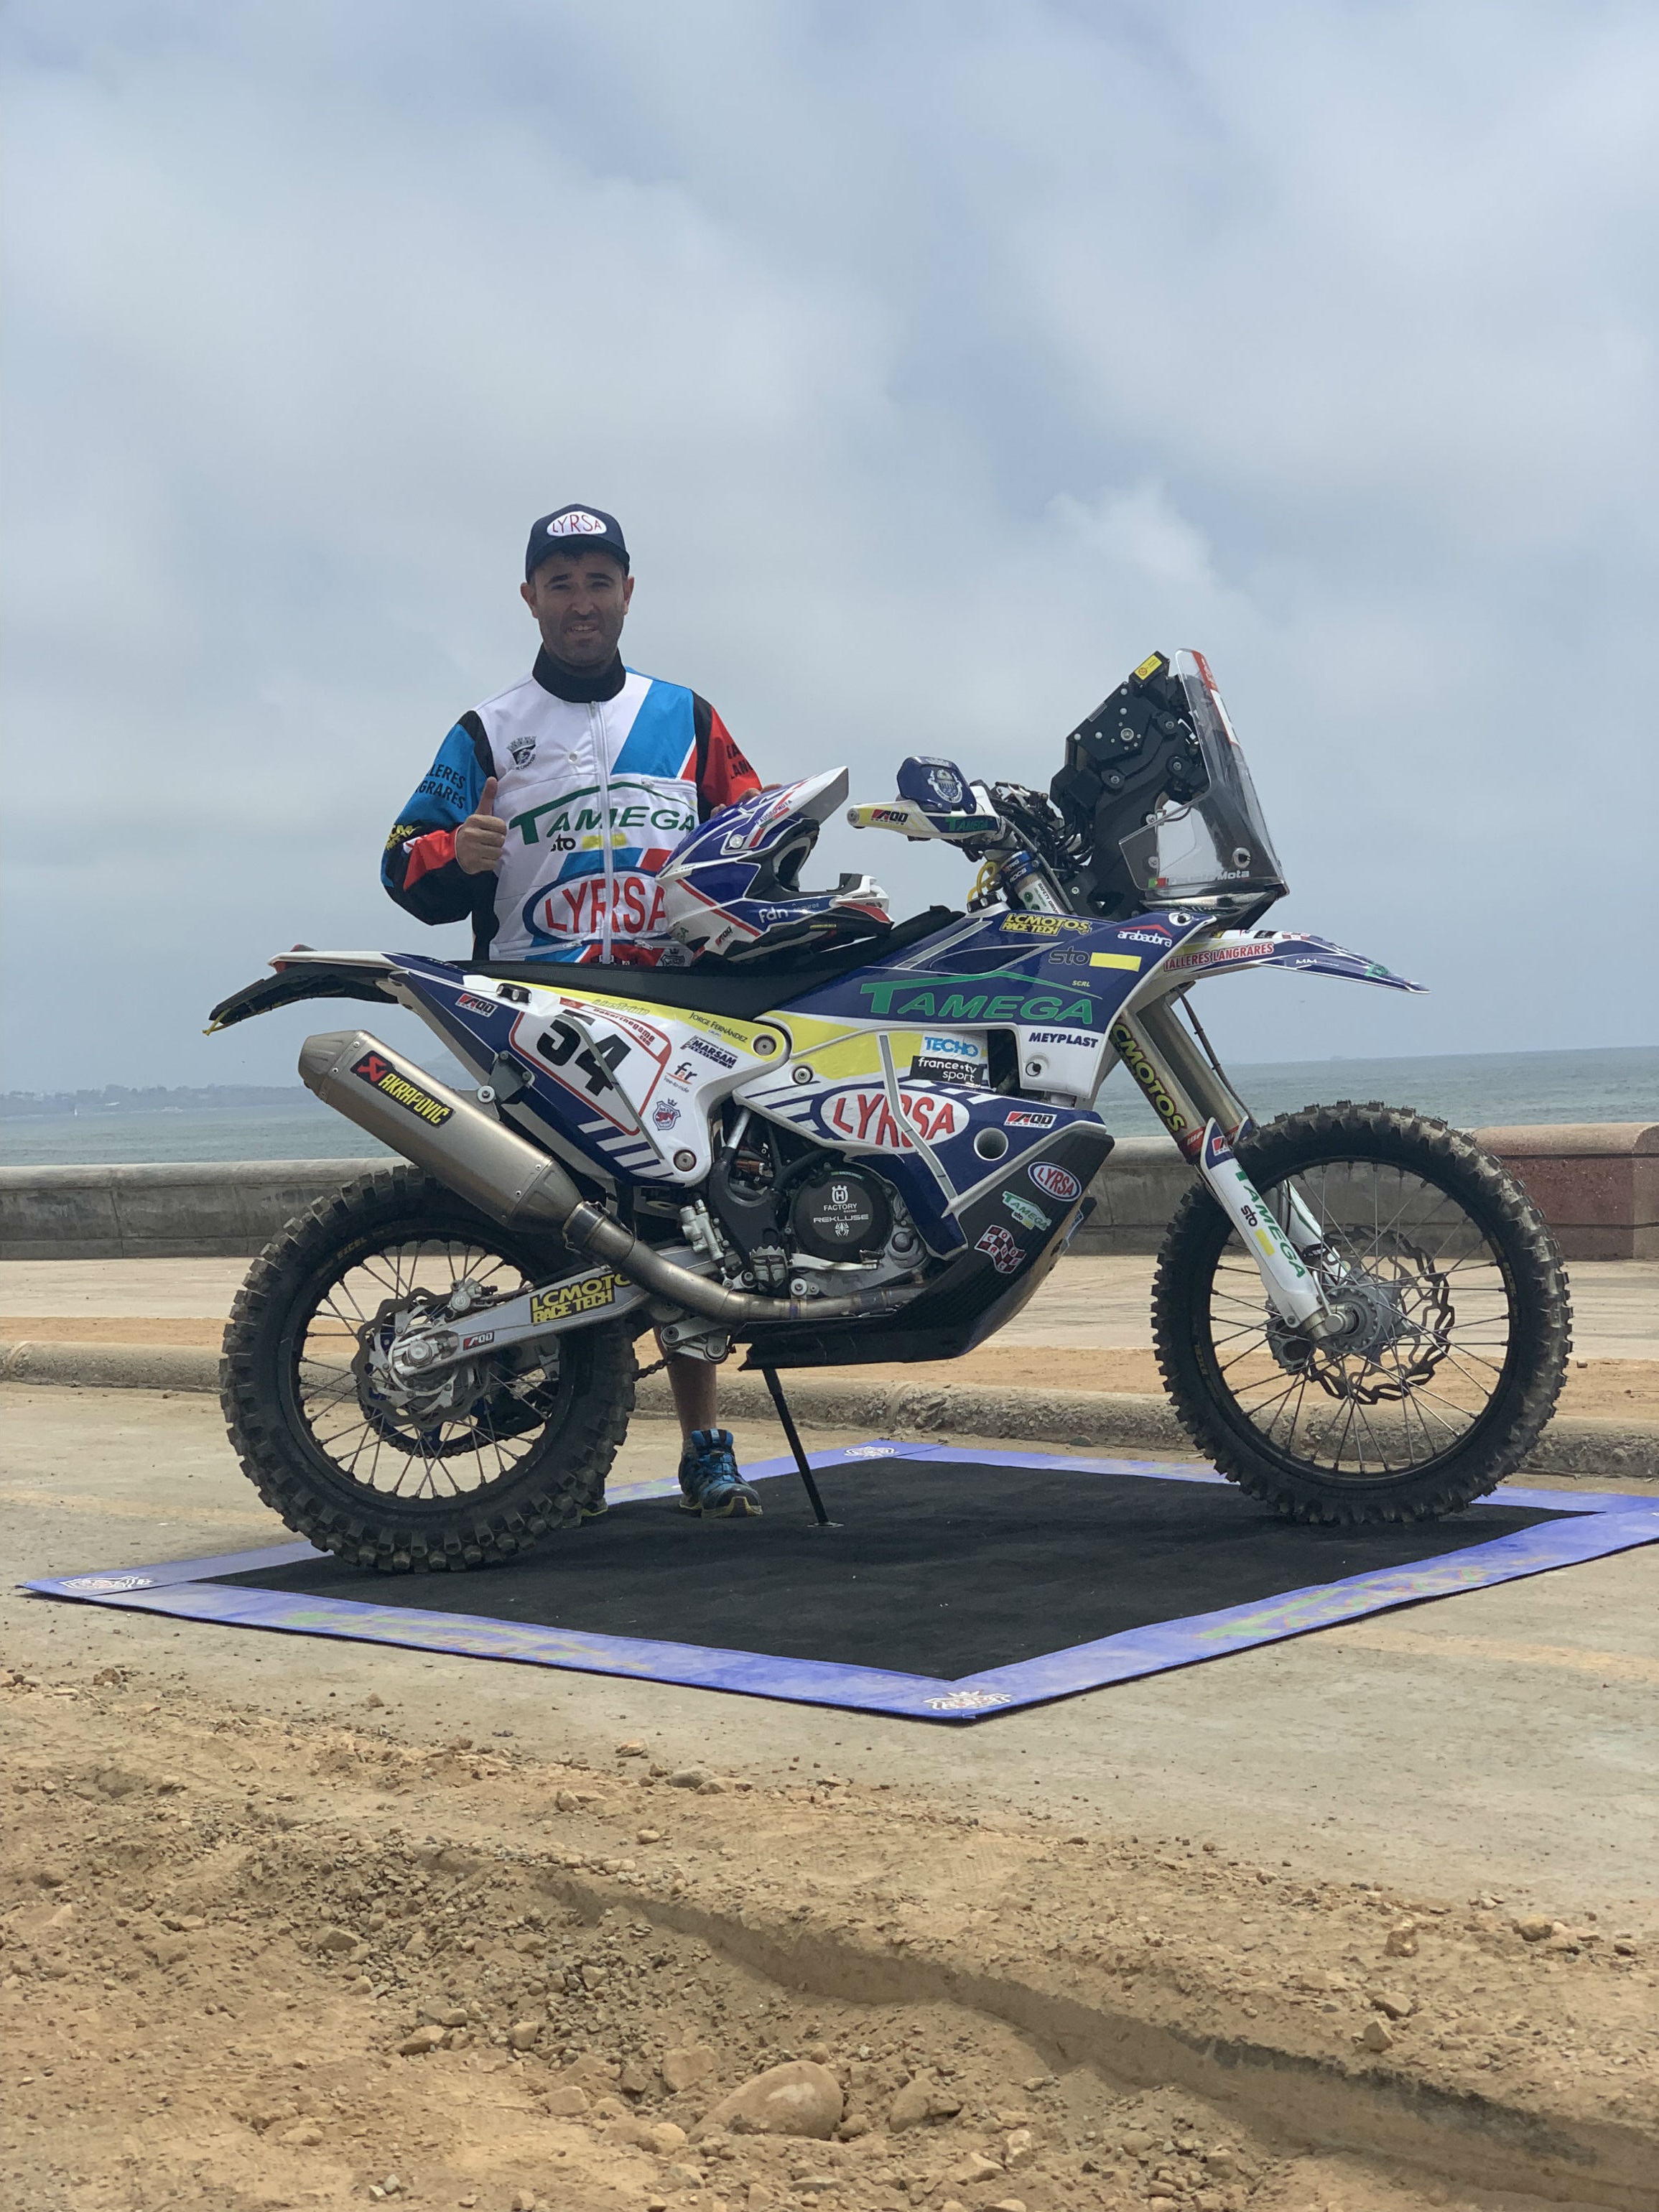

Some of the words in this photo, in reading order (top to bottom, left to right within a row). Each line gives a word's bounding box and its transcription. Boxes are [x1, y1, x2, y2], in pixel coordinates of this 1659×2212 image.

[552, 514, 602, 534] LYRSA
[426, 764, 465, 789] LERES
[509, 784, 695, 845] TAMEGA
[1216, 870, 1250, 881] Mota
[545, 877, 666, 934] LYRSA
[1002, 922, 1029, 931] RACE
[1031, 924, 1059, 935] TECH
[1005, 914, 1089, 931] LCMOTOS
[1049, 946, 1089, 966] sto
[1165, 952, 1211, 970] TALLERES
[1212, 943, 1274, 962] LANGRARES
[860, 978, 1093, 1025] TAMEGA
[689, 1012, 710, 1027] JORGE
[692, 1040, 737, 1066] MARSAM
[1028, 1032, 1100, 1049] MEYPLAST
[942, 1071, 975, 1084] sport
[1113, 1023, 1185, 1132] CMOTOS
[833, 1094, 955, 1148] LYRSA
[1036, 1167, 1074, 1196] LYRSA
[813, 1214, 869, 1223] REKLUSE
[824, 1203, 858, 1212] FACTORY
[1004, 1193, 1049, 1230] TAMEGA
[1241, 1204, 1258, 1227] sto
[531, 1273, 631, 1310] LCMOTO
[532, 1304, 572, 1323] RACE
[573, 1291, 613, 1311] TECH
